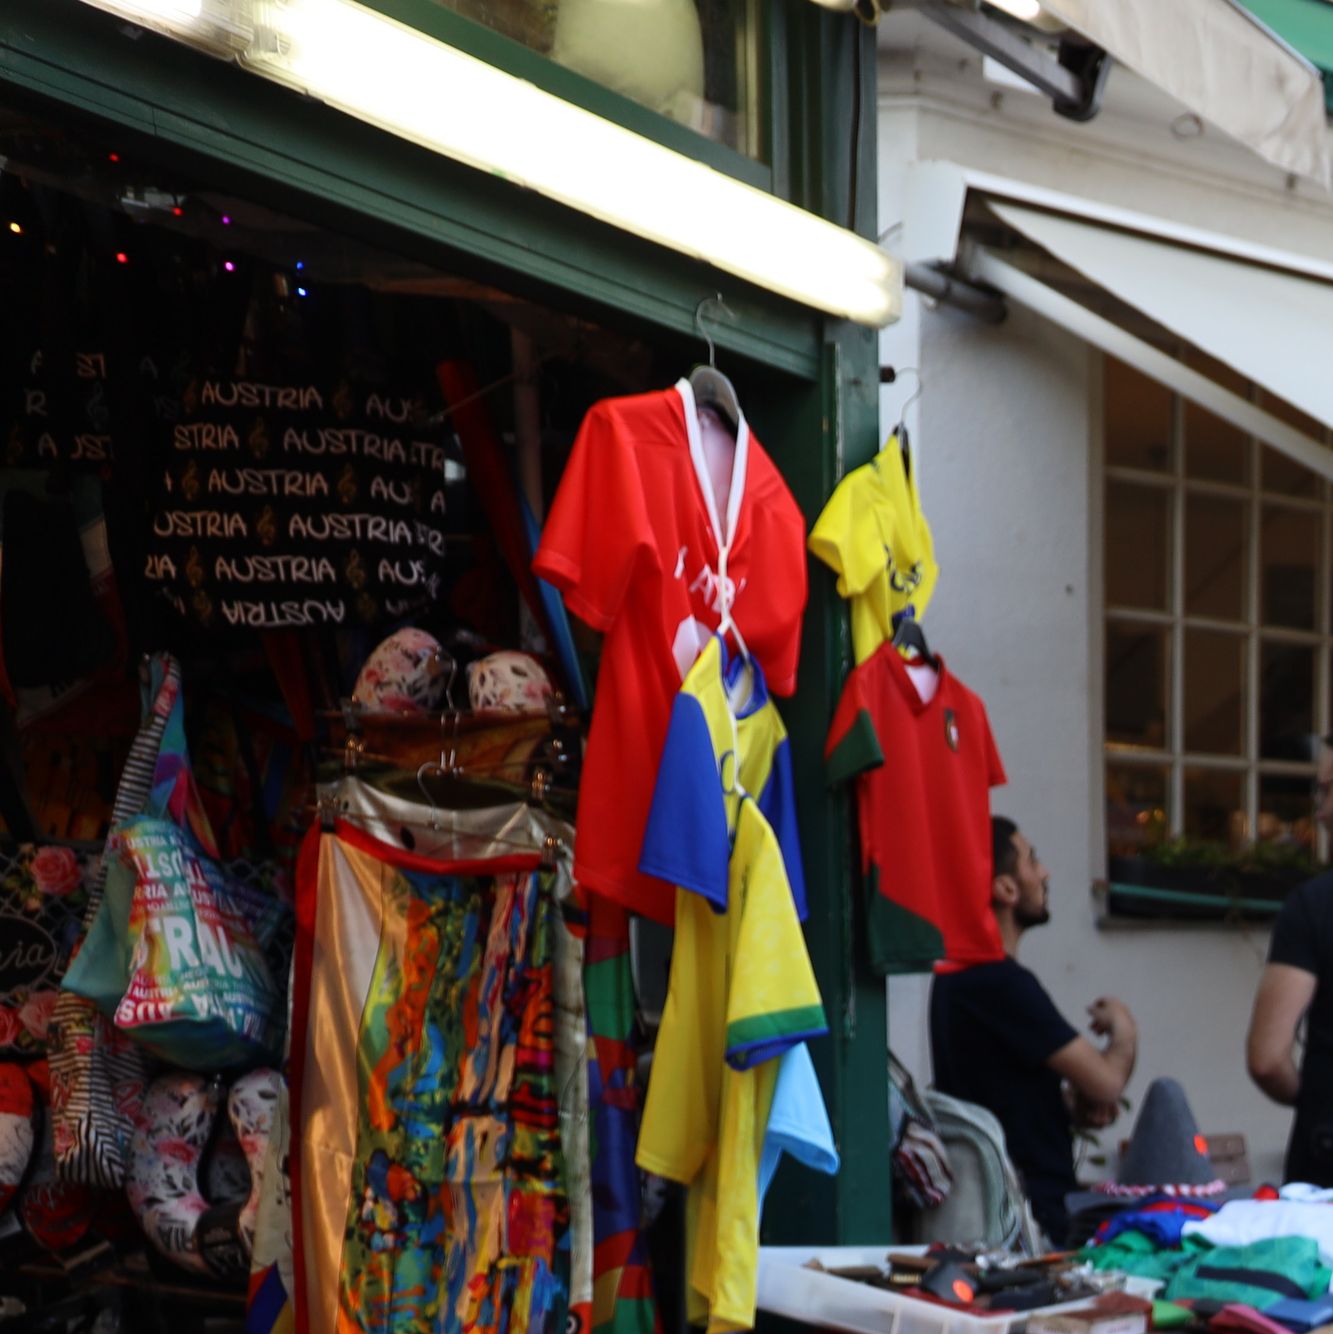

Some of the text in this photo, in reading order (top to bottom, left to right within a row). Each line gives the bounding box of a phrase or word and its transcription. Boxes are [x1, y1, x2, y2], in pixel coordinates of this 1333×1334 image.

[201, 380, 324, 412] AUSTRIA
[281, 426, 409, 464] AUSTRIA
[207, 466, 331, 498] AUSTRIA
[288, 512, 412, 546] AUSTRIA
[214, 555, 337, 584] AUSTRIA
[221, 599, 346, 628] AUSTRIA
